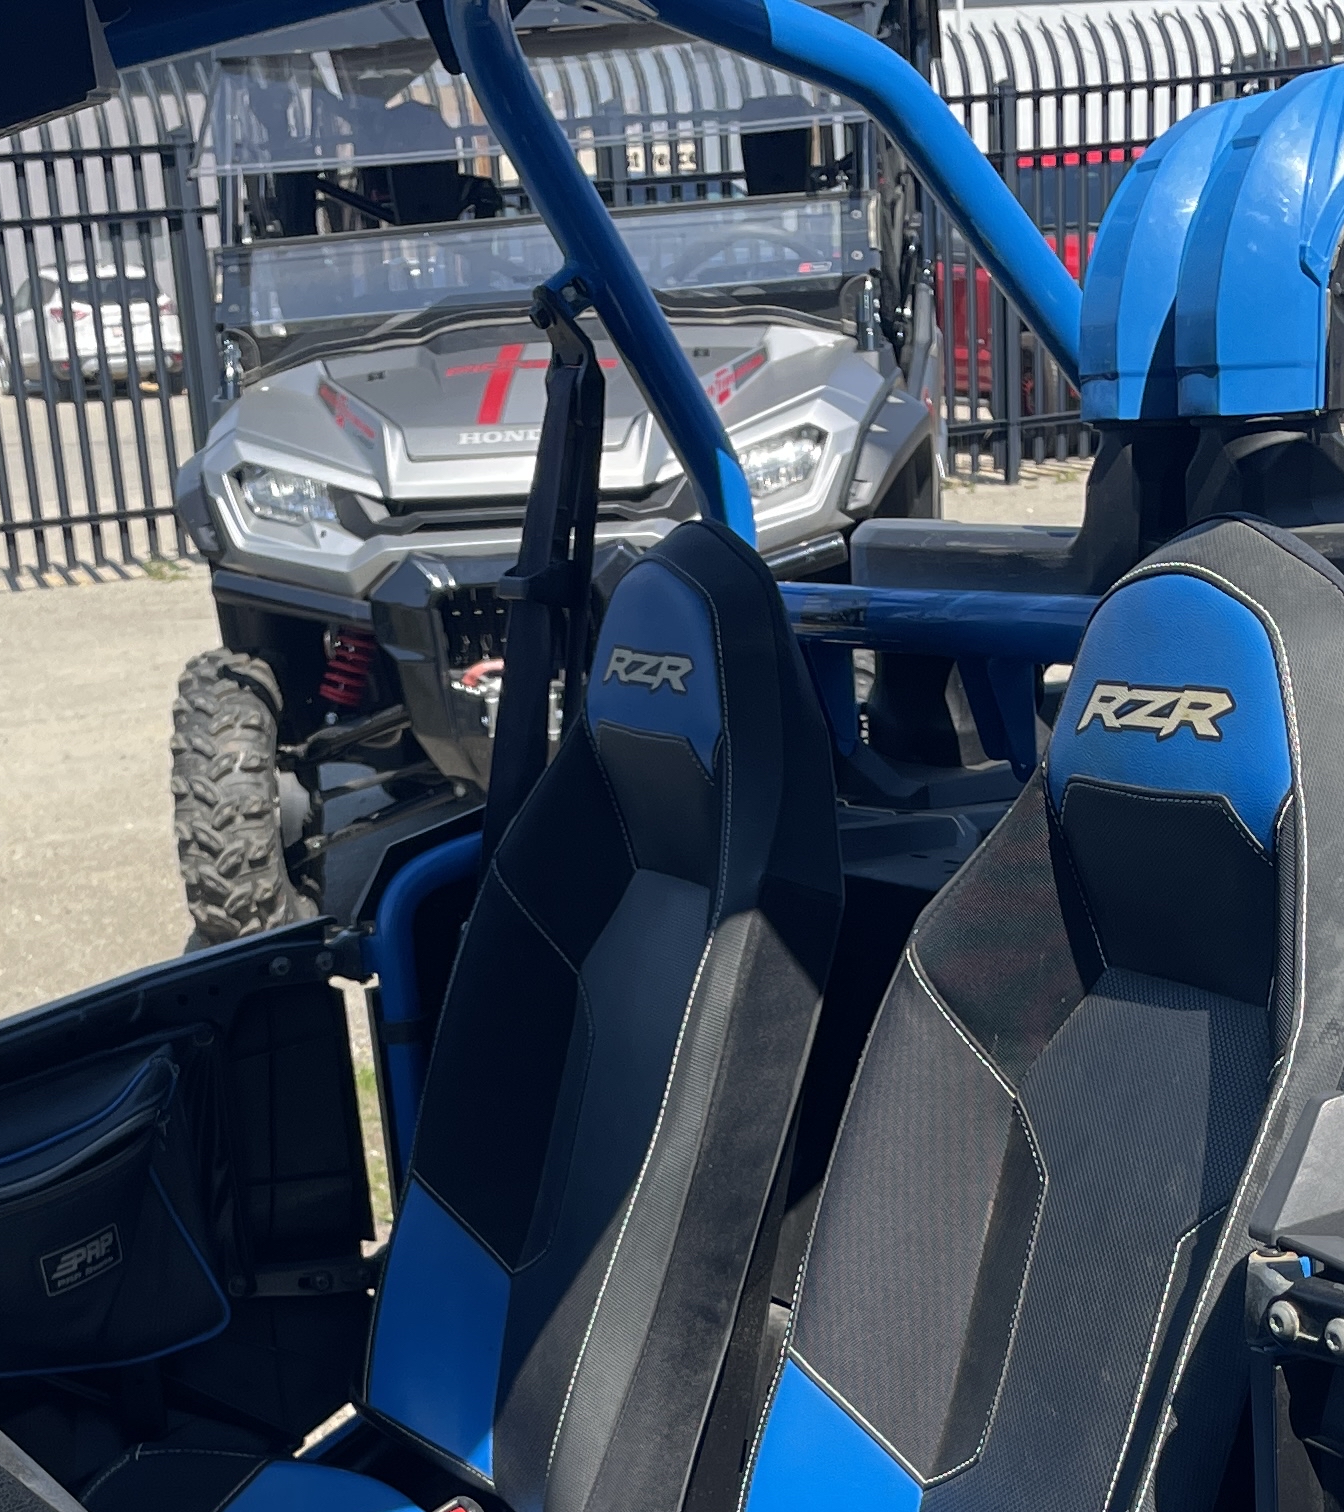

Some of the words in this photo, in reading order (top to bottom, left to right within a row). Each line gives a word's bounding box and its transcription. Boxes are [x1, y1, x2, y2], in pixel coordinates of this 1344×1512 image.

[457, 428, 543, 446] HOND
[602, 645, 693, 694] RZR
[1076, 681, 1236, 741] RZR
